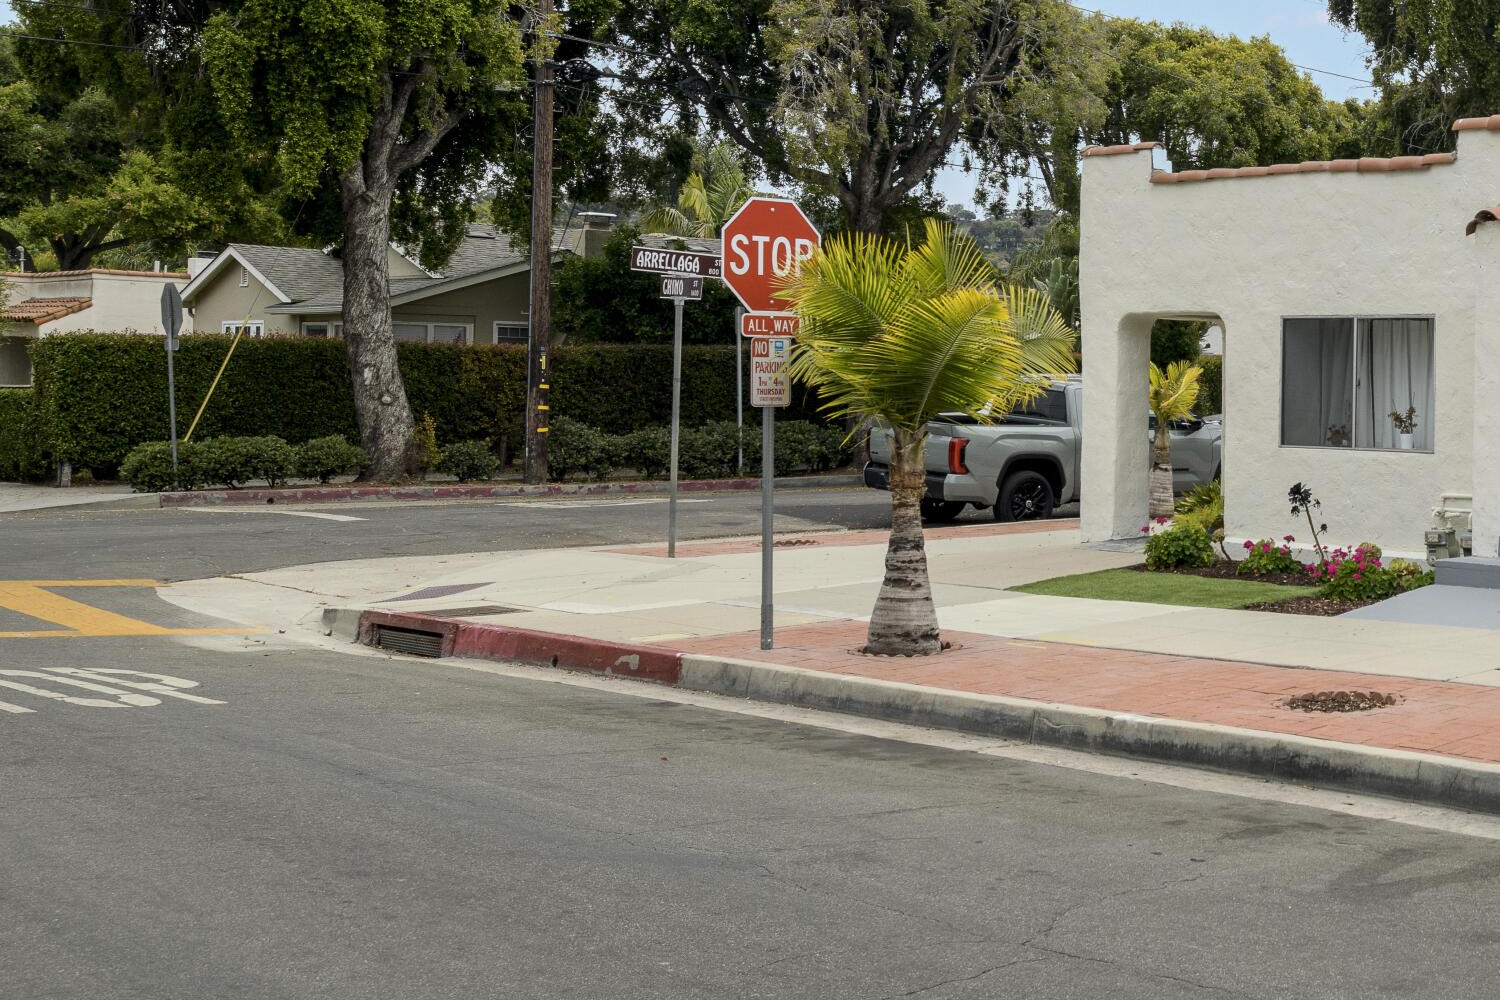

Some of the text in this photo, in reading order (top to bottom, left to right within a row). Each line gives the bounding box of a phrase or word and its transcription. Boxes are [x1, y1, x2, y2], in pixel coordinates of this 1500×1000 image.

[636, 250, 700, 273] ARRELLAGA
[729, 233, 814, 278] STOP
[662, 278, 684, 296] CHINO
[748, 318, 795, 333] ALL WAY
[754, 340, 768, 356] NO
[756, 388, 785, 396] THURSDAY
